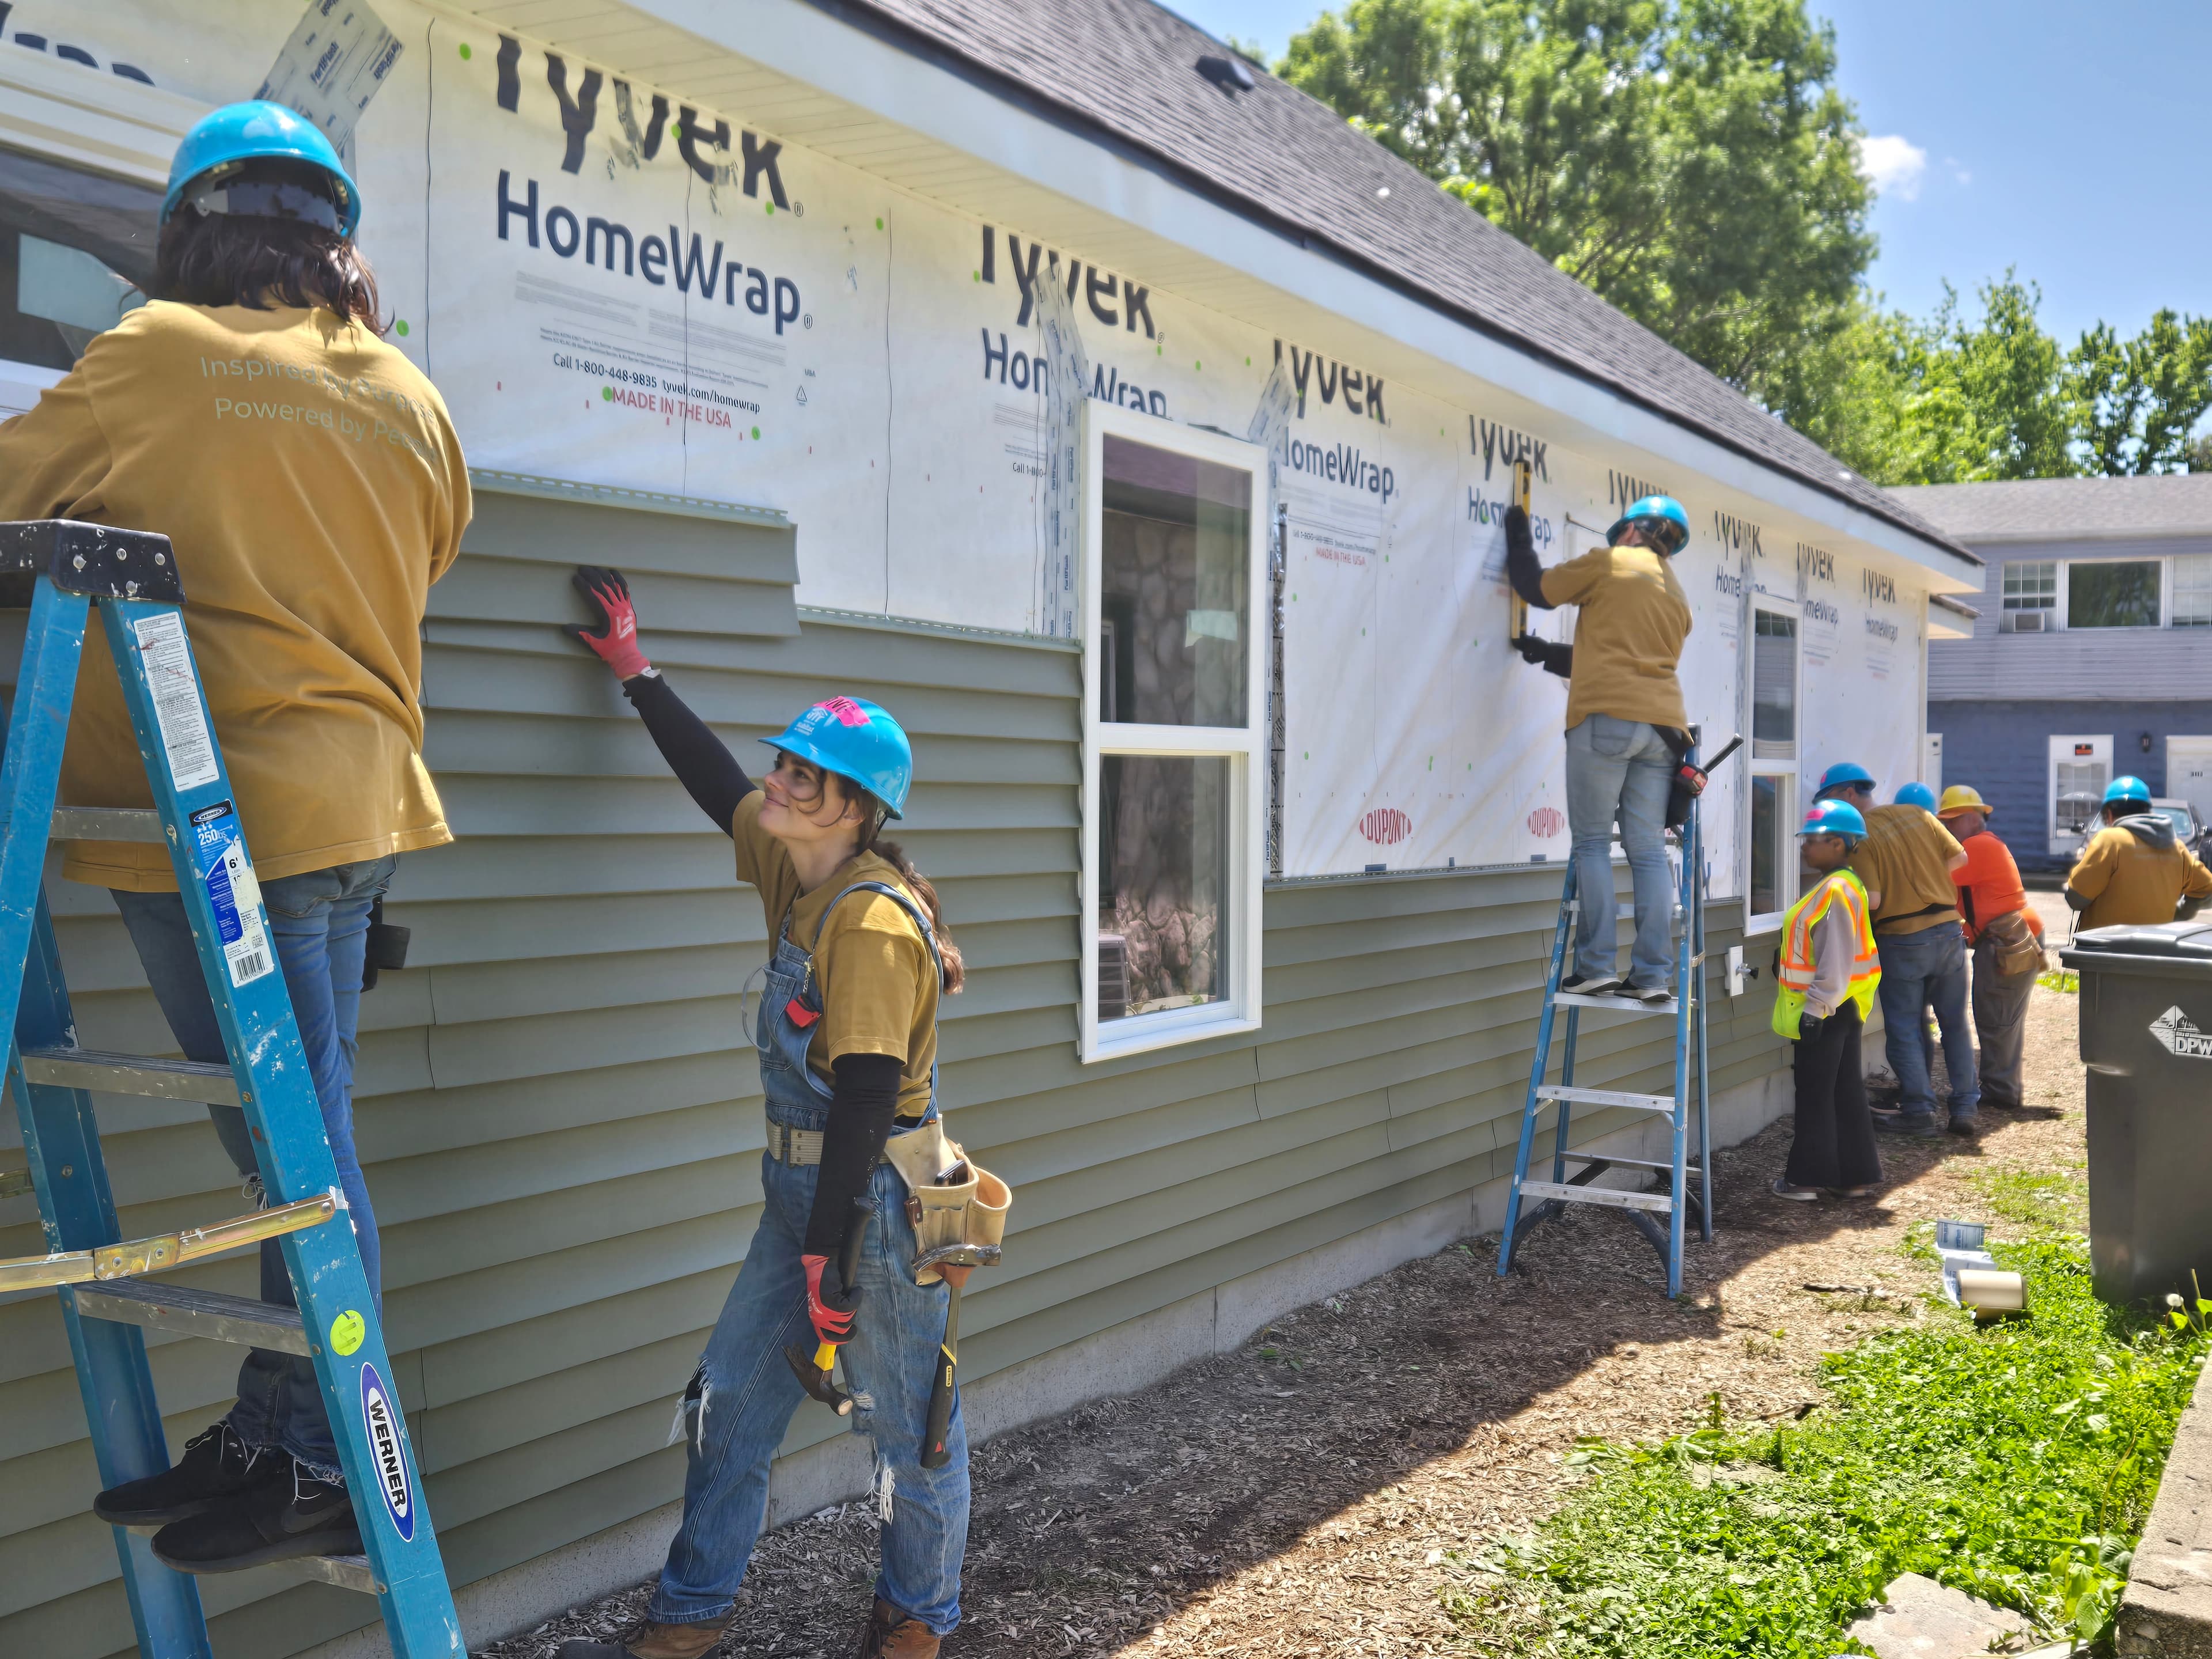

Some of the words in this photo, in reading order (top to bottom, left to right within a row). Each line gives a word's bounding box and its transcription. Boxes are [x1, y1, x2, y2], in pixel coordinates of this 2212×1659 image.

[497, 168, 800, 335] HomeWrap
[201, 356, 316, 384] Inspired
[323, 367, 351, 401] by
[554, 352, 573, 369] Call
[982, 327, 1168, 419] HoWrap
[1274, 339, 1385, 425] yvek
[215, 397, 334, 429] Powered
[340, 410, 367, 442] by
[612, 387, 656, 412] MADE
[660, 396, 674, 415] IN
[678, 400, 703, 421] THE
[707, 407, 731, 428] USA
[1013, 462, 1025, 474] Call
[1468, 486, 1551, 550] Homrap
[1366, 808, 1406, 844] DUPONT
[1531, 806, 1562, 838] DUPONT
[229, 857, 238, 869] 6'
[369, 1399, 407, 1508] WERNER
